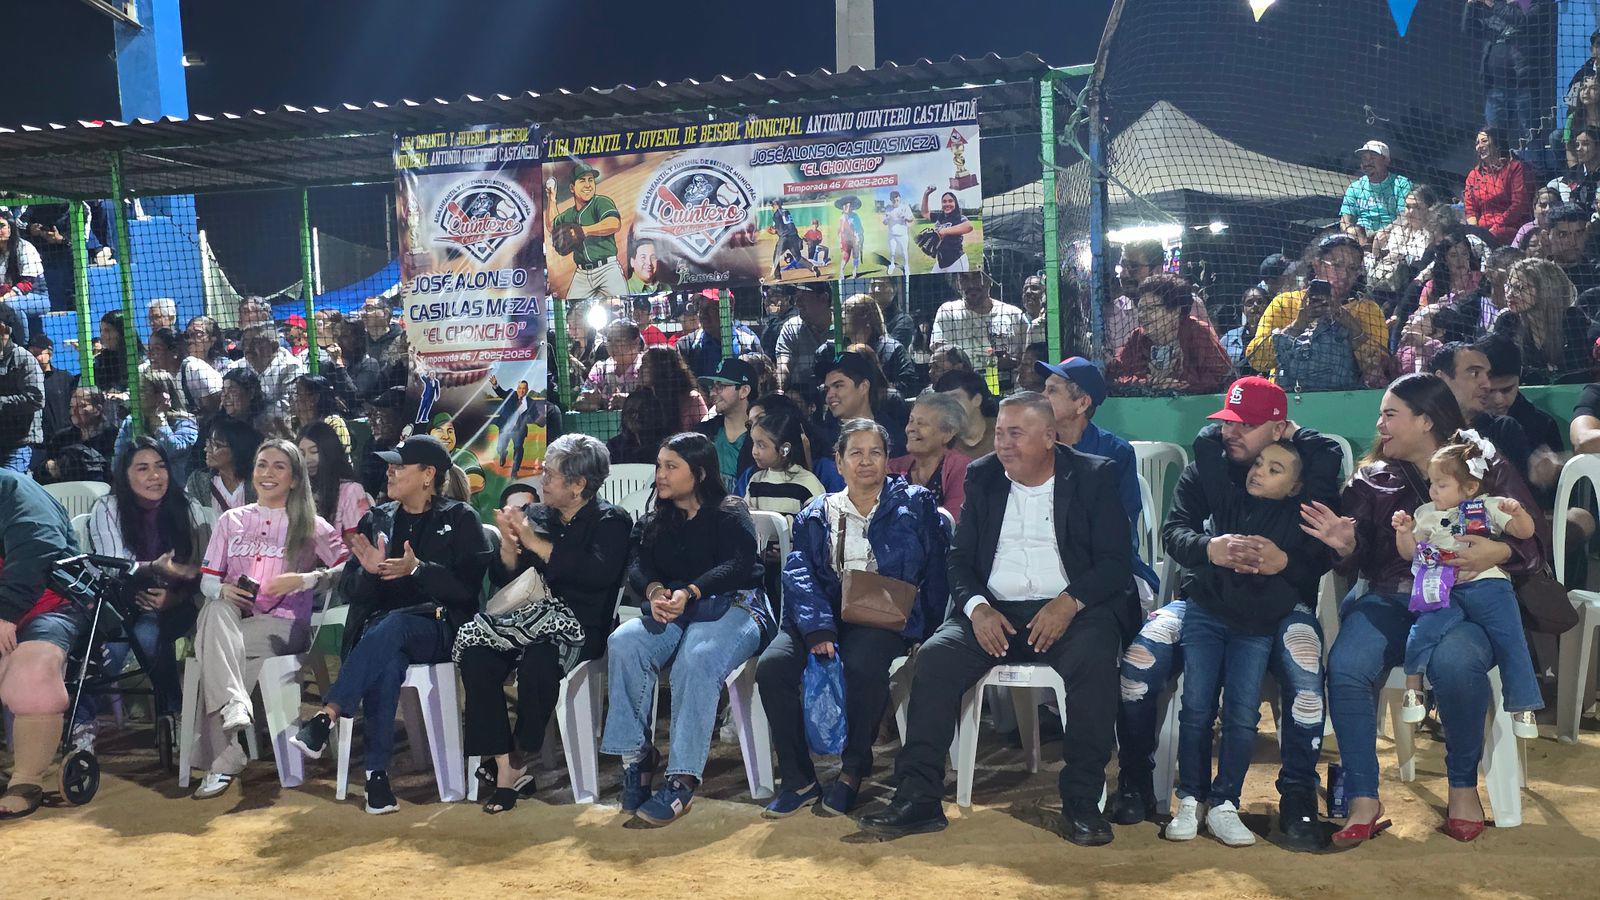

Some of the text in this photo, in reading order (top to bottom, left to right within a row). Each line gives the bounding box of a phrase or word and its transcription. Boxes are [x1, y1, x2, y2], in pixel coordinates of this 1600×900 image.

[416, 132, 448, 150] INFANTIL
[449, 131, 455, 147] Y
[456, 130, 487, 147] JUVENIL
[548, 100, 977, 158] LIGA INFANTIL Y JUVENIL DE BEISBOL MUNICIPAL ANTONIO QUINTERO CASTAÑEDA
[430, 149, 461, 166] ANTONIO
[499, 144, 539, 162] CASTAÑEDA
[751, 135, 940, 165] JOSÉ ALONSO CASILLAS MEZA
[787, 183, 828, 193] Temporada
[829, 180, 841, 189] 46
[660, 198, 739, 225] Quintero
[449, 213, 517, 236] Quintero
[411, 268, 527, 295] JOSÉ ALONSO
[410, 296, 540, 322] CASILLAS MEZA
[459, 352, 472, 361] 46
